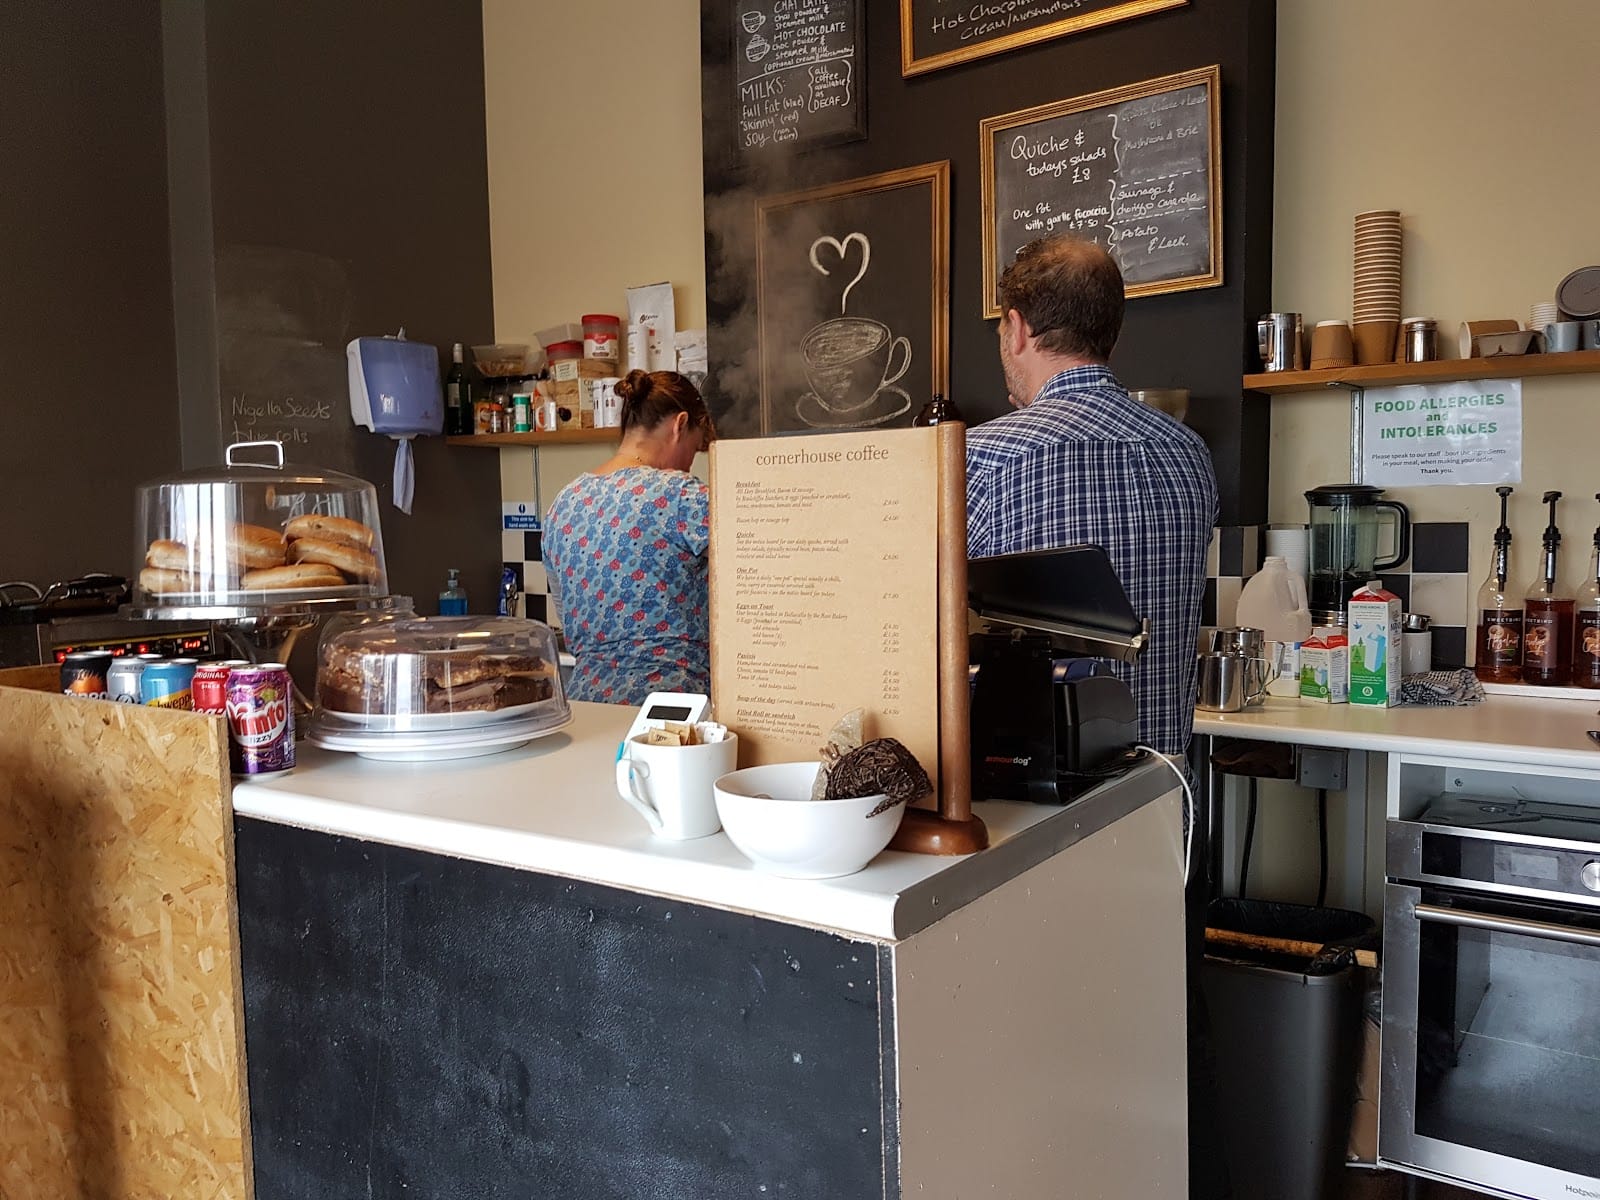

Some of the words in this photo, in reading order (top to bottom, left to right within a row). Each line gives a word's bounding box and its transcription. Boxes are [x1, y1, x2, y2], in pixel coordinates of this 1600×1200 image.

[774, 0, 797, 13] CHAI
[794, 8, 821, 19] powder
[931, 13, 966, 33] Hot
[774, 31, 795, 42] HOT
[796, 22, 846, 37] CHOCOLATE
[792, 37, 819, 48] powder
[814, 64, 828, 75] all
[815, 72, 839, 84] coffee
[741, 76, 787, 102] MILKS:
[814, 78, 846, 90] available
[742, 103, 761, 119] full
[764, 99, 781, 115] fat
[813, 95, 841, 111] DECAF
[780, 110, 799, 125] (red)
[1176, 125, 1199, 138] Brie
[1010, 135, 1070, 160] Quiche
[1074, 129, 1085, 147] &
[1026, 160, 1068, 178] todays
[1069, 146, 1107, 167] salads
[1072, 166, 1091, 184] £8
[1013, 209, 1033, 220] One
[1035, 202, 1052, 214] Pot
[1025, 220, 1044, 231] with
[1046, 211, 1072, 231] garlic
[231, 392, 283, 426] Nigella
[285, 398, 331, 419] Seeds
[1374, 400, 1417, 414] FOOD
[1419, 392, 1506, 410] ALLERGIES
[1425, 412, 1450, 423] and
[1380, 422, 1498, 440] INTOLERANCES
[755, 448, 842, 466] cornerhouse
[846, 444, 890, 462] coffee
[1371, 453, 1391, 461] Please
[1391, 453, 1409, 461] speak
[1442, 450, 1460, 458] bout
[1461, 457, 1476, 465] your
[766, 697, 776, 705] day
[228, 698, 286, 737] Vimto
[736, 708, 753, 717] Filled
[752, 710, 765, 718] Roll
[771, 712, 796, 720] sandwich
